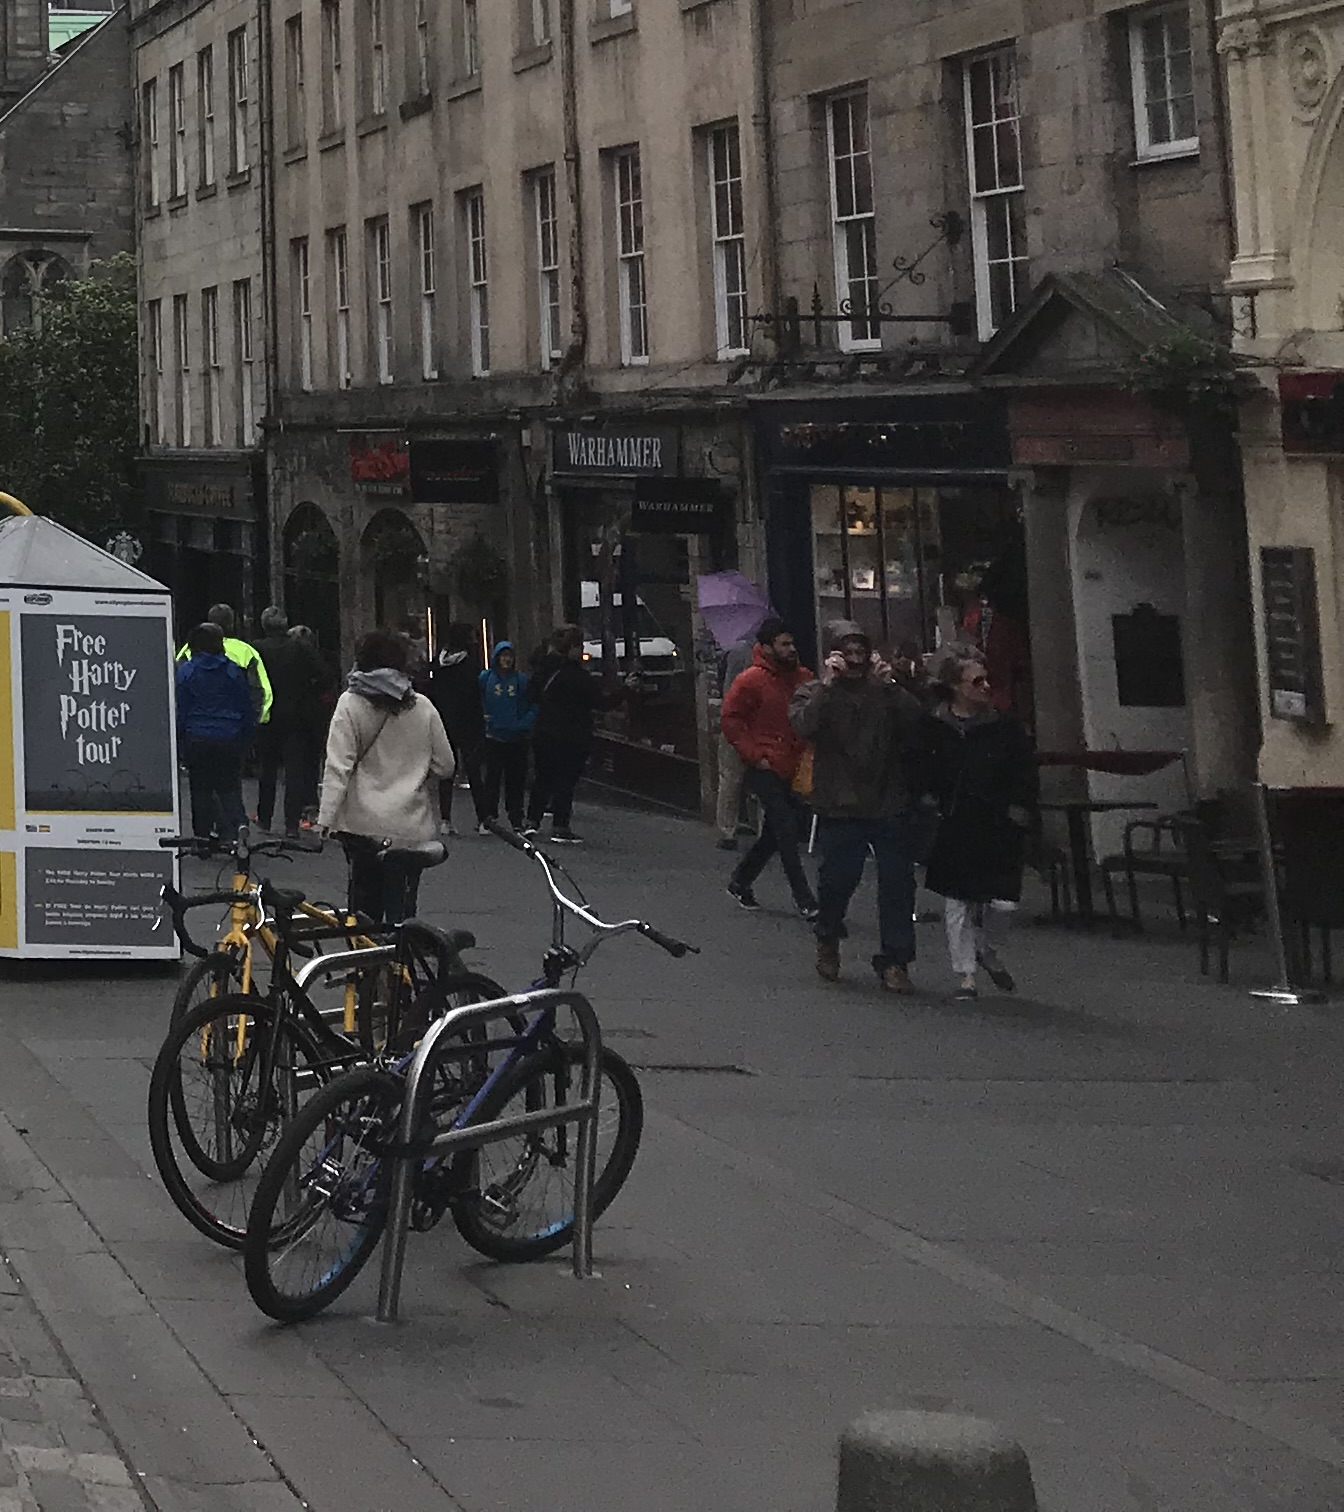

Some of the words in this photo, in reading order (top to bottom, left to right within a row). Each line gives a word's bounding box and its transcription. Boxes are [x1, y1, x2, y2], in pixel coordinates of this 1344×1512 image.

[568, 433, 661, 468] WARHAMMER
[638, 500, 714, 513] WARHAMMER
[56, 624, 106, 667] Free
[69, 659, 137, 695] Harry
[59, 694, 130, 740] Potter
[76, 734, 121, 765] tour
